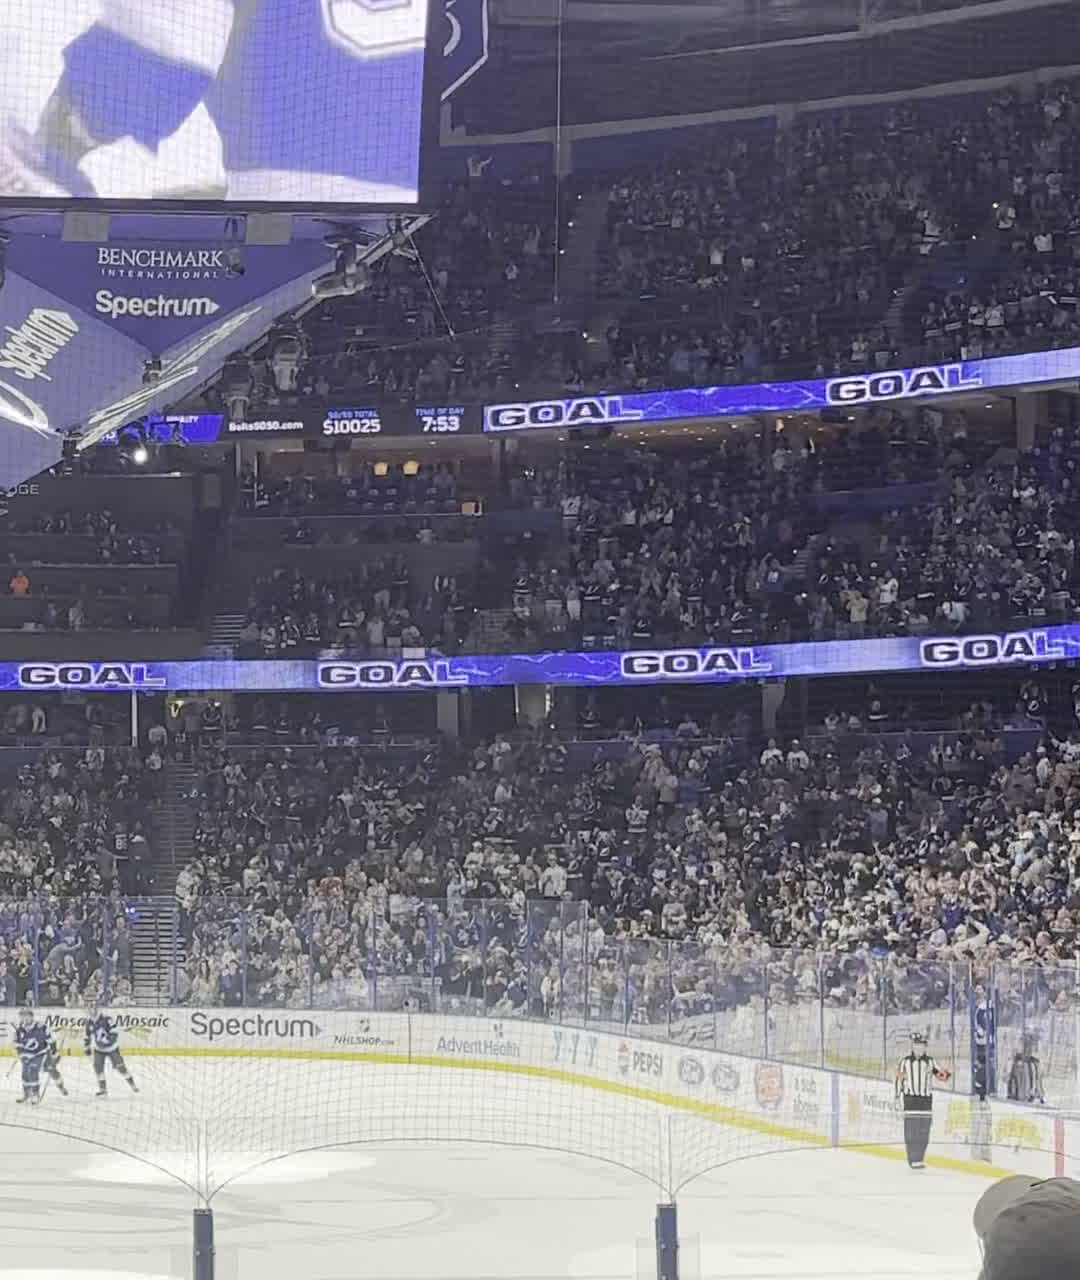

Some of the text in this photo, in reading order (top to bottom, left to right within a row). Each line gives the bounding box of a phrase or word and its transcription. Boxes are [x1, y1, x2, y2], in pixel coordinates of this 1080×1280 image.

[98, 247, 224, 268] BENCHMARK
[101, 269, 220, 280] INTERNATIONAL
[95, 289, 213, 320] Spectrum
[825, 363, 983, 405] GOAL
[354, 409, 379, 419] TOTAL
[448, 407, 465, 416] DAY
[487, 396, 643, 431] GOAL
[323, 419, 381, 435] $10025
[422, 416, 460, 432] 7:53
[919, 631, 1066, 669] GOAL
[318, 661, 469, 688] GOAL
[620, 647, 772, 679] GOAL
[18, 663, 167, 688] GOAL
[45, 1014, 87, 1027] Mosa
[115, 1013, 170, 1028] Mosaic
[191, 1012, 314, 1041] Spectrum
[436, 1036, 521, 1057] AdventHealth
[632, 1051, 664, 1076] PEPSI
